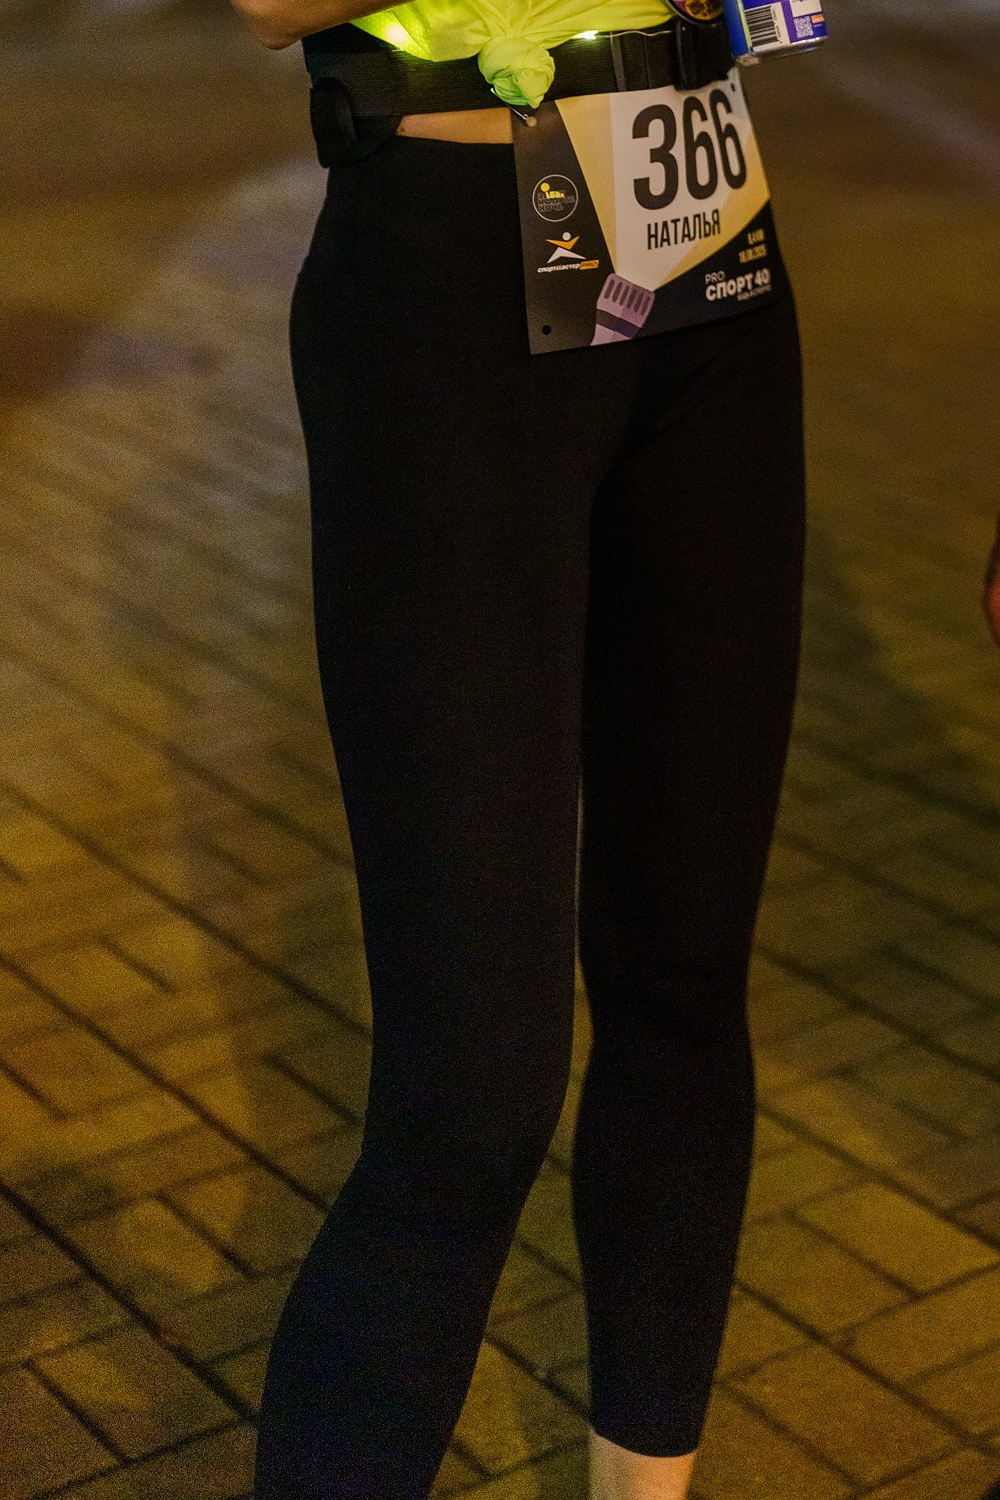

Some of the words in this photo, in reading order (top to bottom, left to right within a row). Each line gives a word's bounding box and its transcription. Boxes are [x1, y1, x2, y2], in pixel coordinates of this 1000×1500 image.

[632, 88, 747, 211] 366
[647, 209, 721, 250] НАТАЛЬЯ
[705, 270, 725, 285] PRO
[705, 273, 753, 301] СПОРТ
[754, 268, 771, 286] 40
